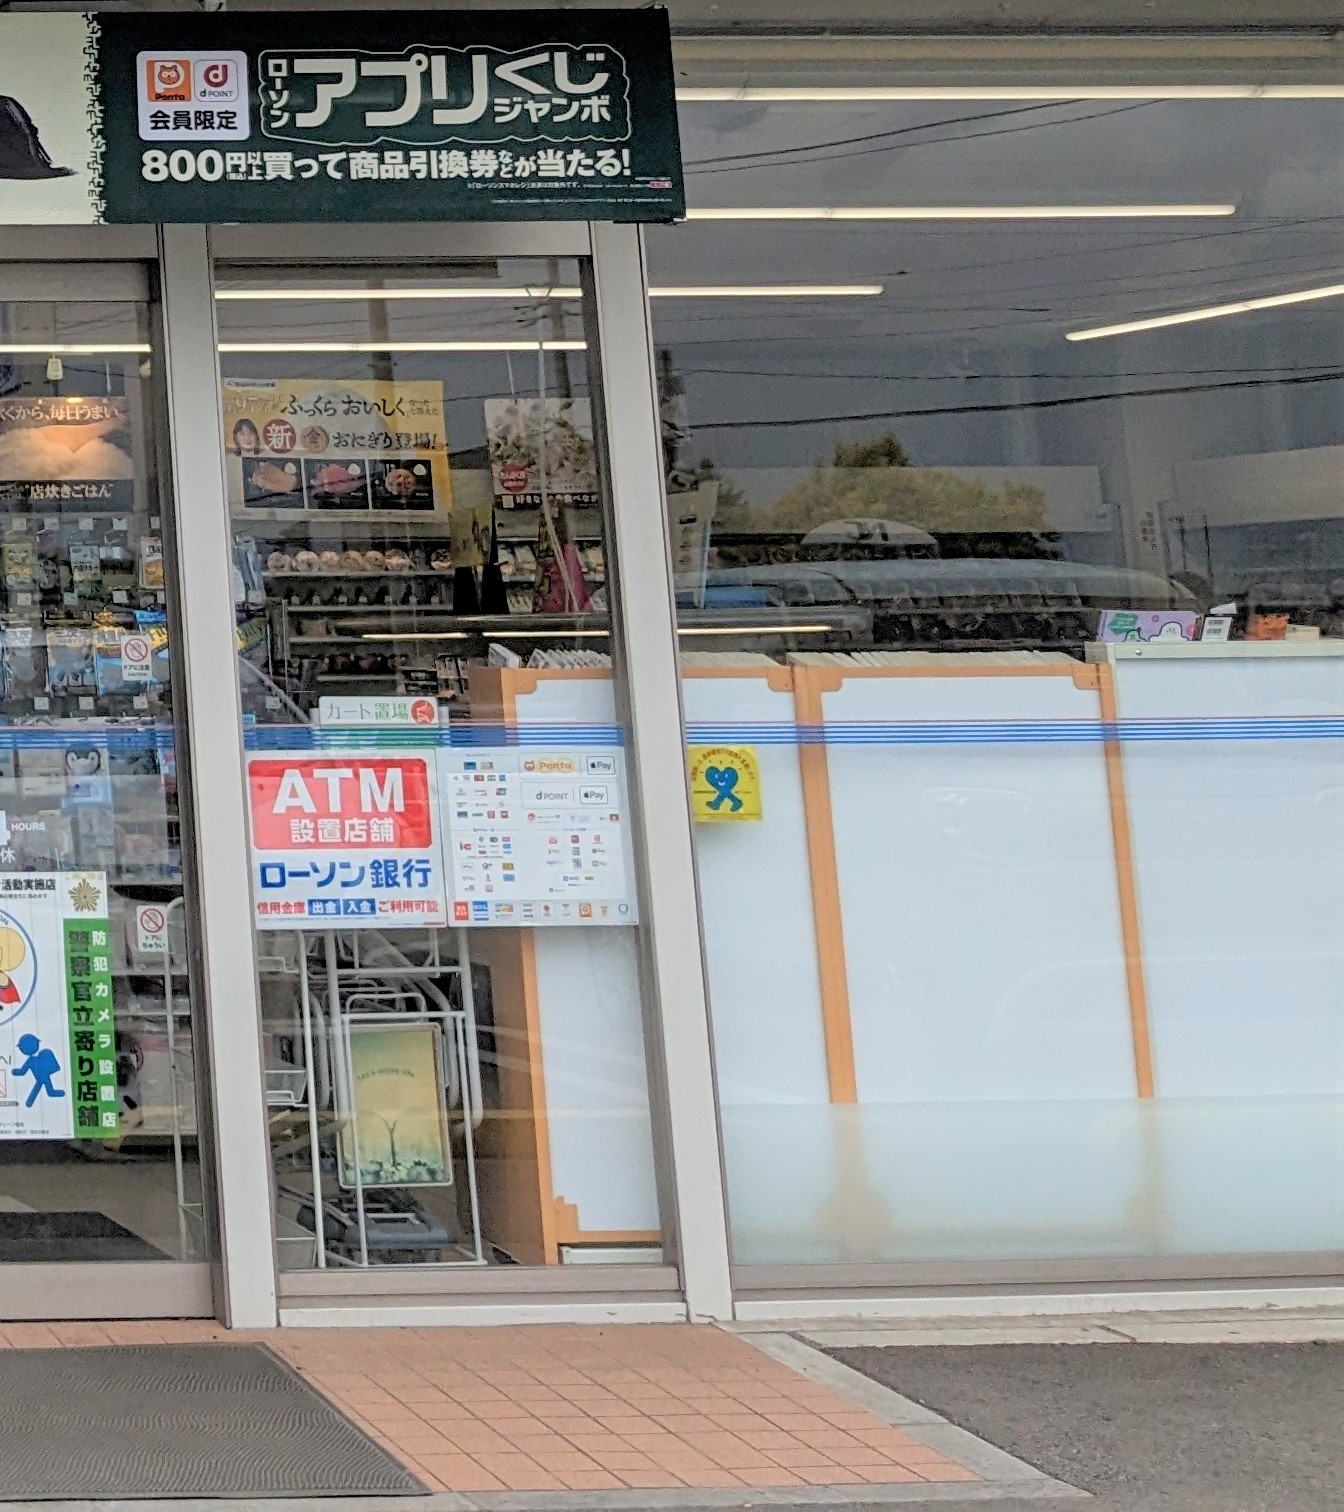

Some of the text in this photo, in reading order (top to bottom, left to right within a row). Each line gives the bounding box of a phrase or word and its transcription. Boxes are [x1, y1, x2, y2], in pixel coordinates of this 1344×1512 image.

[267, 58, 291, 129] ローソン
[293, 51, 610, 128] アプリくじ
[149, 110, 238, 131] 会員限定
[493, 94, 611, 123] ジャンボ
[267, 423, 293, 449] 新
[326, 701, 409, 720] カート置場
[596, 761, 612, 771] Pay
[272, 768, 405, 814] ATM
[589, 791, 605, 800] Pay
[11, 822, 46, 831] HOURS
[289, 817, 395, 844] 設置店舗
[259, 858, 433, 889] ローソン銀行
[256, 901, 306, 915] 信用金庫
[311, 900, 337, 915] 出金
[346, 900, 372, 914] 入金
[378, 899, 439, 914] ご利用可能
